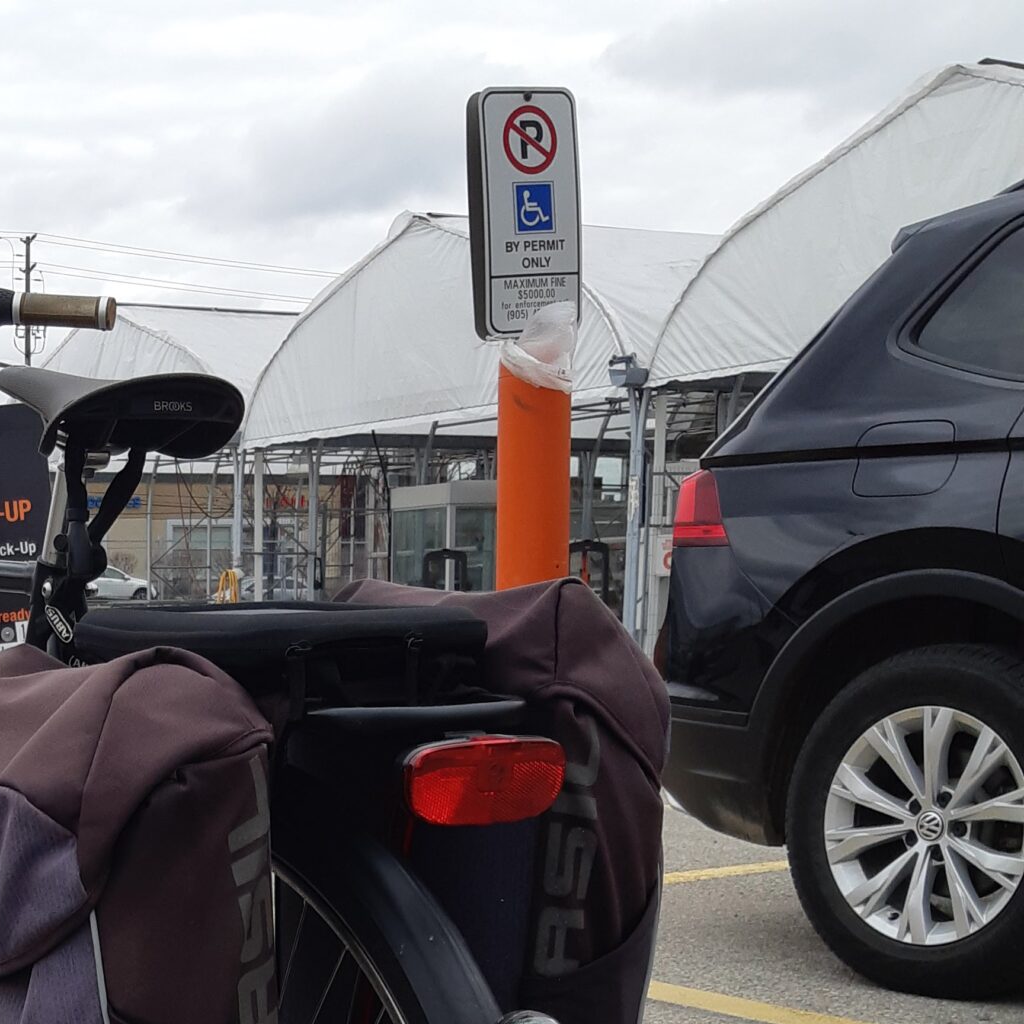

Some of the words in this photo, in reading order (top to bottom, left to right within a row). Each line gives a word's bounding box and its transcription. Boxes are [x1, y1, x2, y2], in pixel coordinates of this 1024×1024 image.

[505, 241, 520, 252] BY
[524, 239, 566, 252] PERMIT
[521, 256, 551, 269] ONLY
[504, 277, 548, 290] MAXIMUM
[551, 276, 567, 287] FINE
[517, 288, 556, 300] $5000.00
[507, 308, 529, 322] (905)
[153, 400, 193, 413] BROOKS
[47, 607, 70, 639] ABUS
